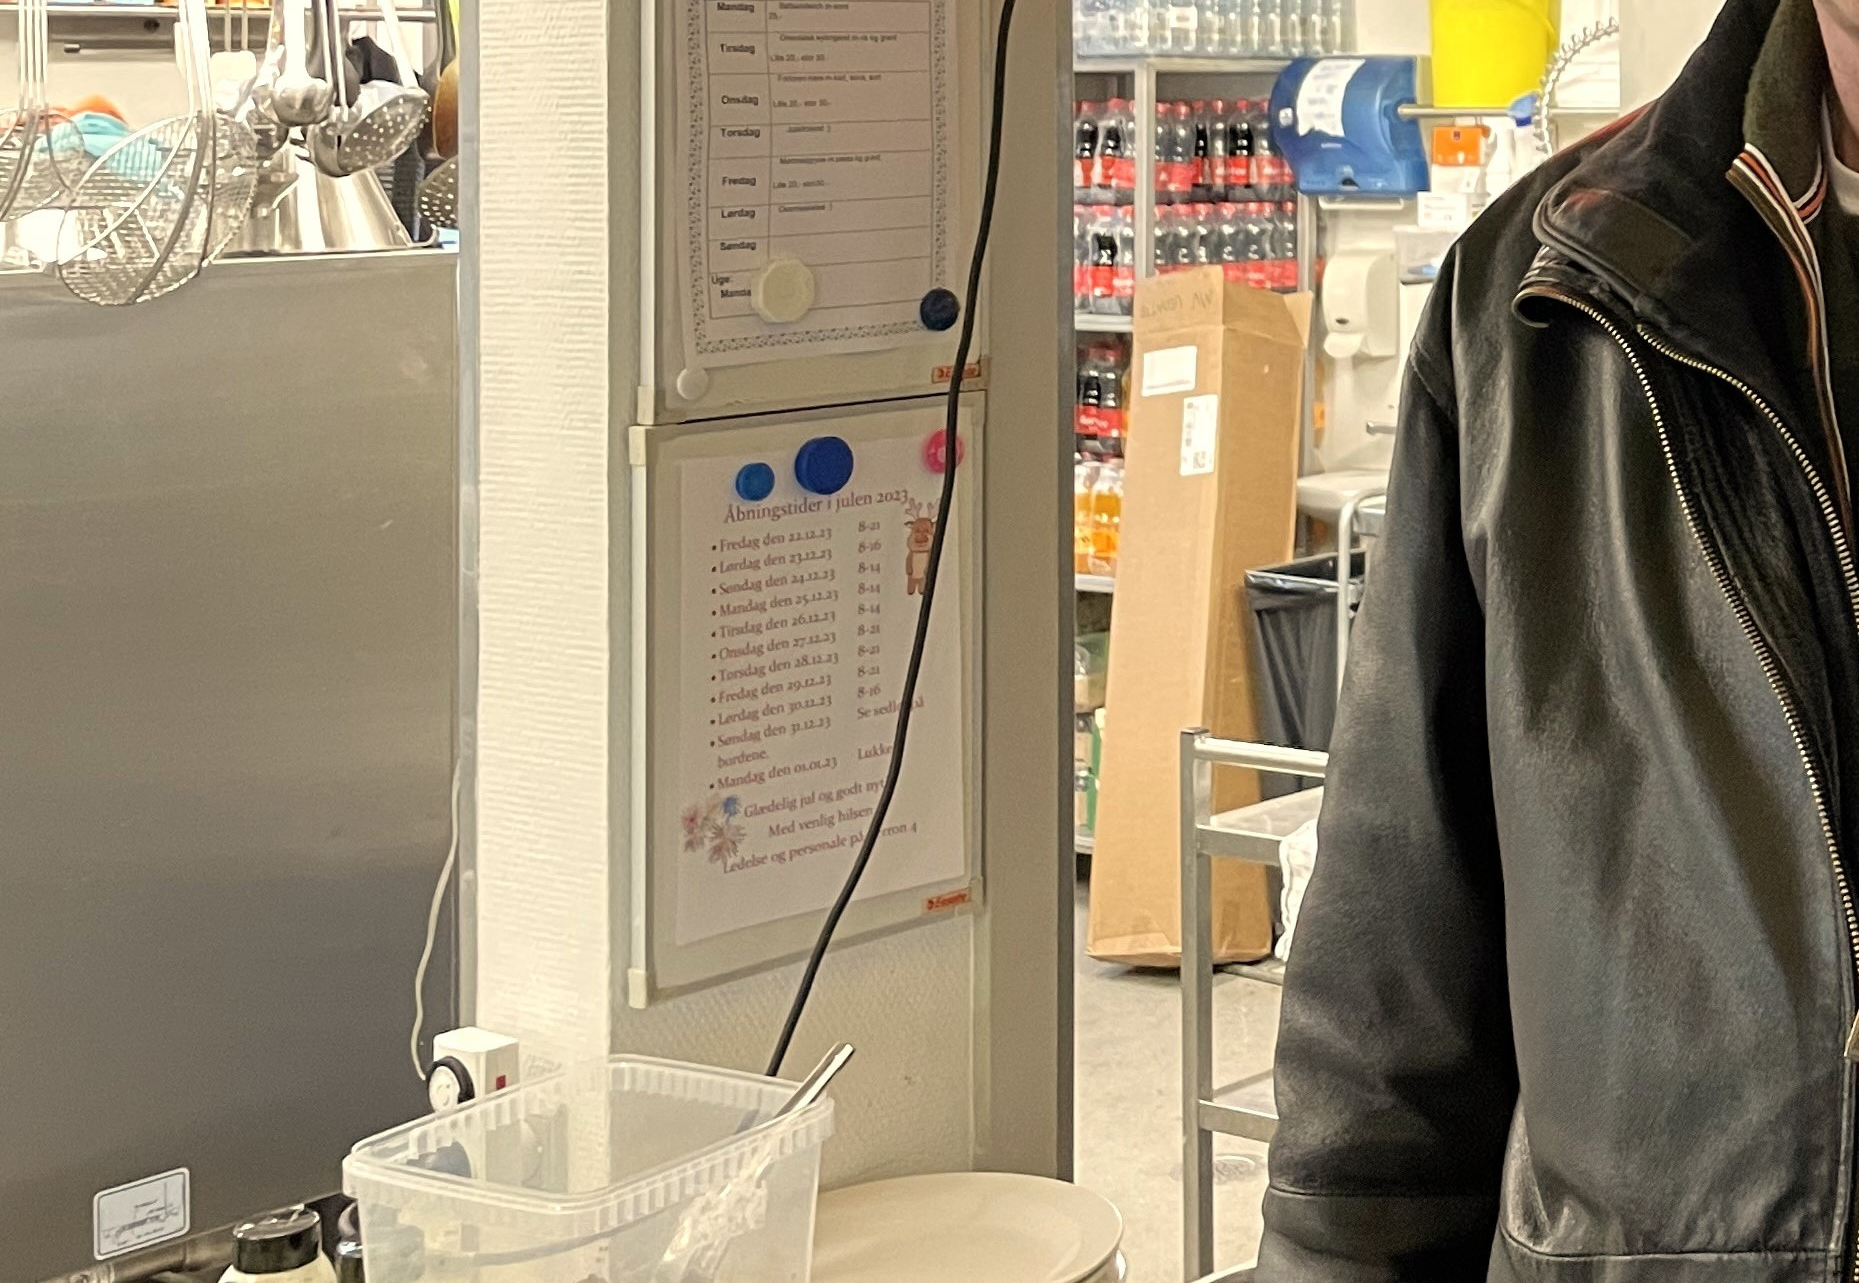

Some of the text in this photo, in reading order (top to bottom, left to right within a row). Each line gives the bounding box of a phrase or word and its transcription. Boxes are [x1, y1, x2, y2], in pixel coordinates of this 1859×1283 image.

[721, 95, 759, 106] Onsdag
[720, 126, 761, 138] Torsdag
[724, 497, 823, 523] Åbningstider
[836, 492, 873, 513] julen
[876, 490, 908, 505] 2023
[720, 537, 760, 552] Fredag
[763, 533, 785, 546] den
[764, 554, 786, 567] den
[766, 574, 788, 587] den
[719, 600, 767, 616] Mandag
[770, 594, 793, 608] den
[720, 621, 763, 638] Tirsdag
[766, 616, 788, 631] den
[719, 642, 764, 660] Onsdag
[767, 637, 789, 651] den
[720, 664, 766, 681] Torsdag
[769, 658, 791, 672] den
[719, 687, 758, 703] Fredag
[761, 682, 784, 696] den
[762, 702, 785, 716] den
[764, 723, 786, 738] den
[717, 772, 765, 790] Mandag
[768, 765, 791, 779] den
[858, 743, 894, 760] Lukke
[744, 796, 797, 818] Glædelig
[799, 791, 815, 809] jul
[818, 790, 834, 804] og
[836, 781, 862, 801] godt
[769, 820, 795, 837] Med
[799, 813, 835, 831] venlig
[723, 853, 768, 874] Ledelse
[771, 850, 786, 864] og
[789, 835, 848, 862] personale
